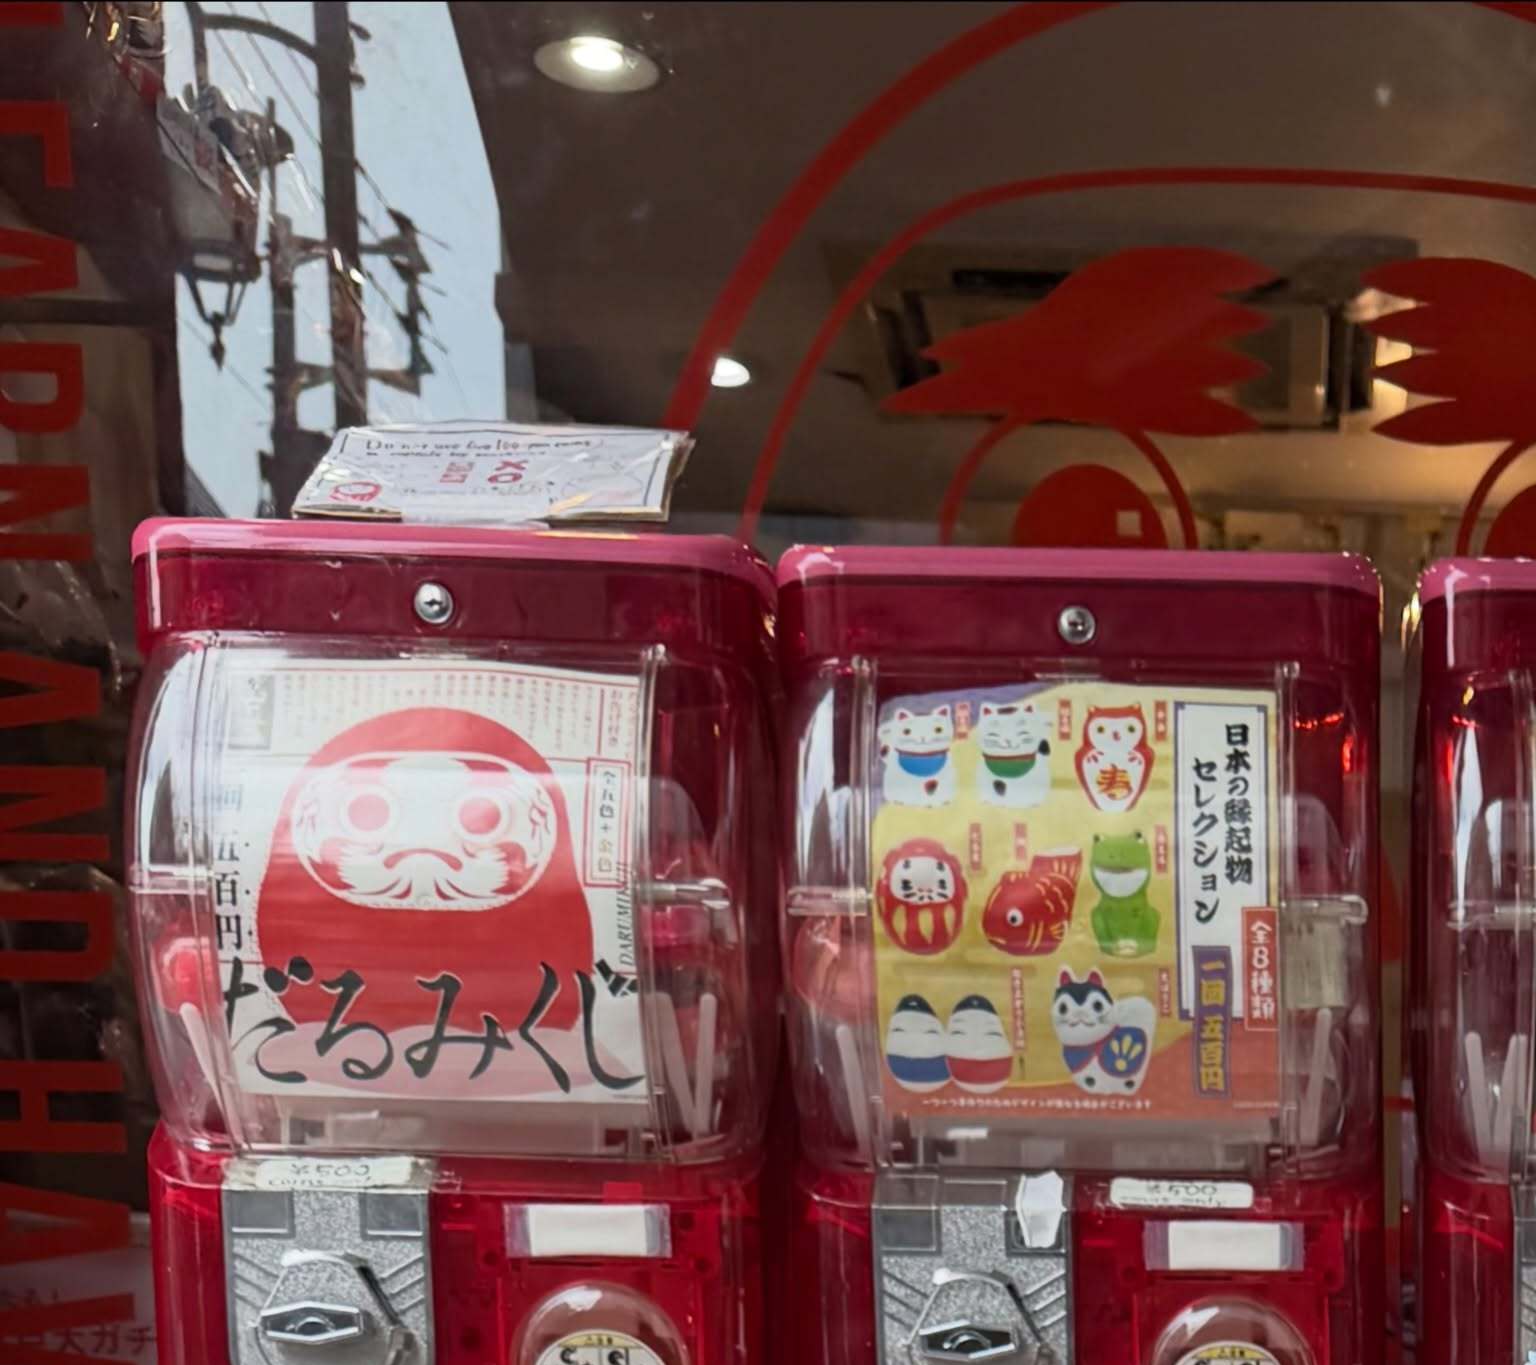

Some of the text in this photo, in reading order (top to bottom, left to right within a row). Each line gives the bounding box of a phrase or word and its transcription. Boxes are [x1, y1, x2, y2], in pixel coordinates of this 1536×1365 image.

[1191, 757, 1221, 925] セレクション
[1223, 723, 1254, 886] 日本の縁起物
[222, 956, 646, 1094] だるみくじ
